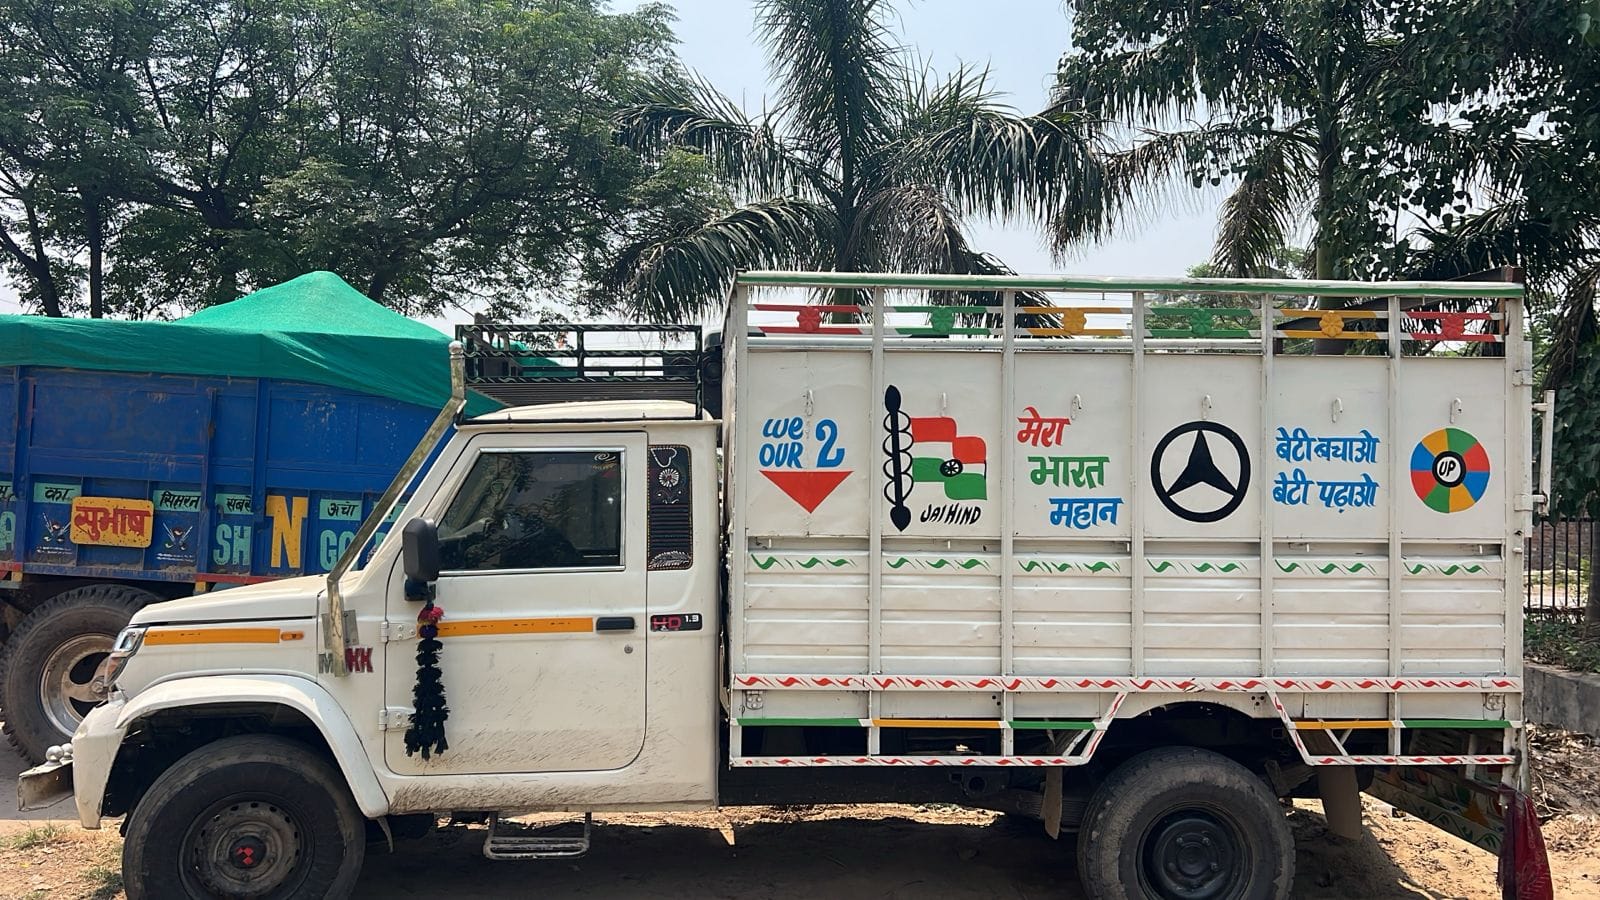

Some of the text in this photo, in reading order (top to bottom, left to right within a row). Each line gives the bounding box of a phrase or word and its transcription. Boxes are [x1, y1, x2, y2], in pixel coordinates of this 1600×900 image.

[815, 418, 845, 468] 2
[1017, 407, 1071, 447] मेरा
[759, 441, 804, 469] OUR
[1276, 427, 1380, 464] बेटी बचाओ
[1027, 456, 1110, 490] भारत
[1439, 460, 1456, 477] UP
[44, 486, 75, 501] का
[1272, 468, 1380, 514] बेटी पढ़ाओ
[75, 506, 151, 541] सुभाष
[920, 502, 982, 525] JAI HIND
[1049, 497, 1123, 529] महान
[266, 496, 308, 568] N
